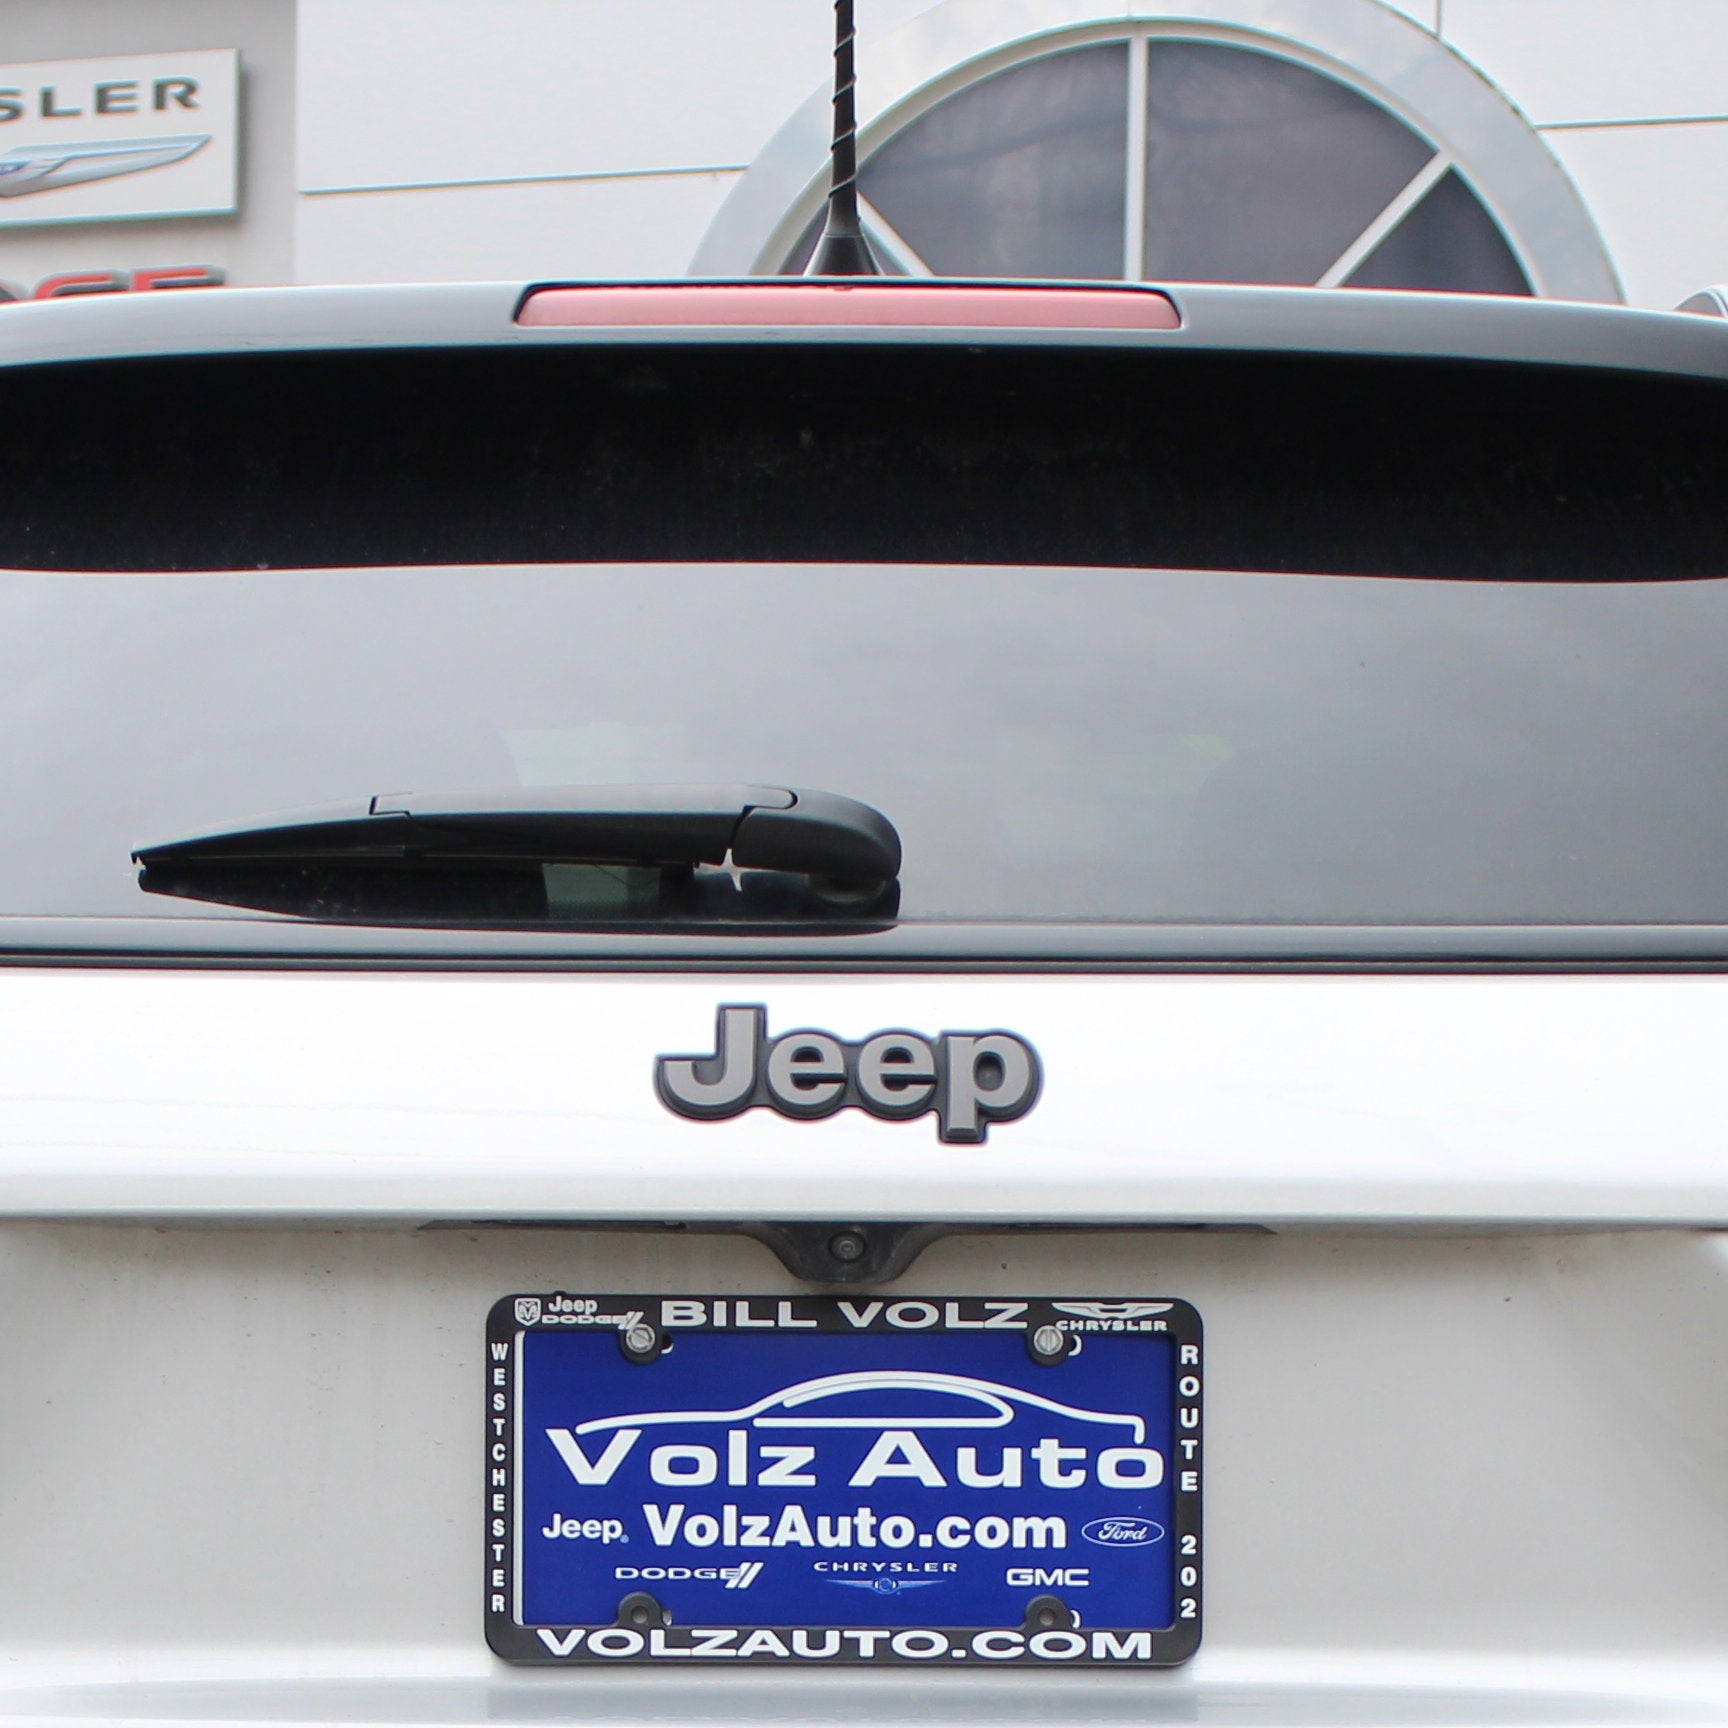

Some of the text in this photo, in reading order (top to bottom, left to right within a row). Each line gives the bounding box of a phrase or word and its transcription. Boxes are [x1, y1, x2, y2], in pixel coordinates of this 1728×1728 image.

[655, 1003, 1044, 1145] Jeep
[541, 1313, 627, 1325] DODGE
[548, 1295, 598, 1315] Jeep
[661, 1300, 1029, 1329] BILL VOLZ
[1055, 1319, 1168, 1332] CHRYSLER
[545, 1428, 1164, 1489] Volz Auto
[491, 1342, 509, 1613] WESTCHESTER
[1179, 1344, 1200, 1618] ROUTE 202
[542, 1513, 622, 1545] Jeep
[642, 1503, 1068, 1549] VolzAuto.com
[1097, 1520, 1148, 1542] Ford
[615, 1567, 738, 1583] DODGE
[813, 1561, 958, 1573] CHRYSLER
[1006, 1568, 1090, 1587] GMC
[536, 1629, 1152, 1659] VOLZAUTO.COM
